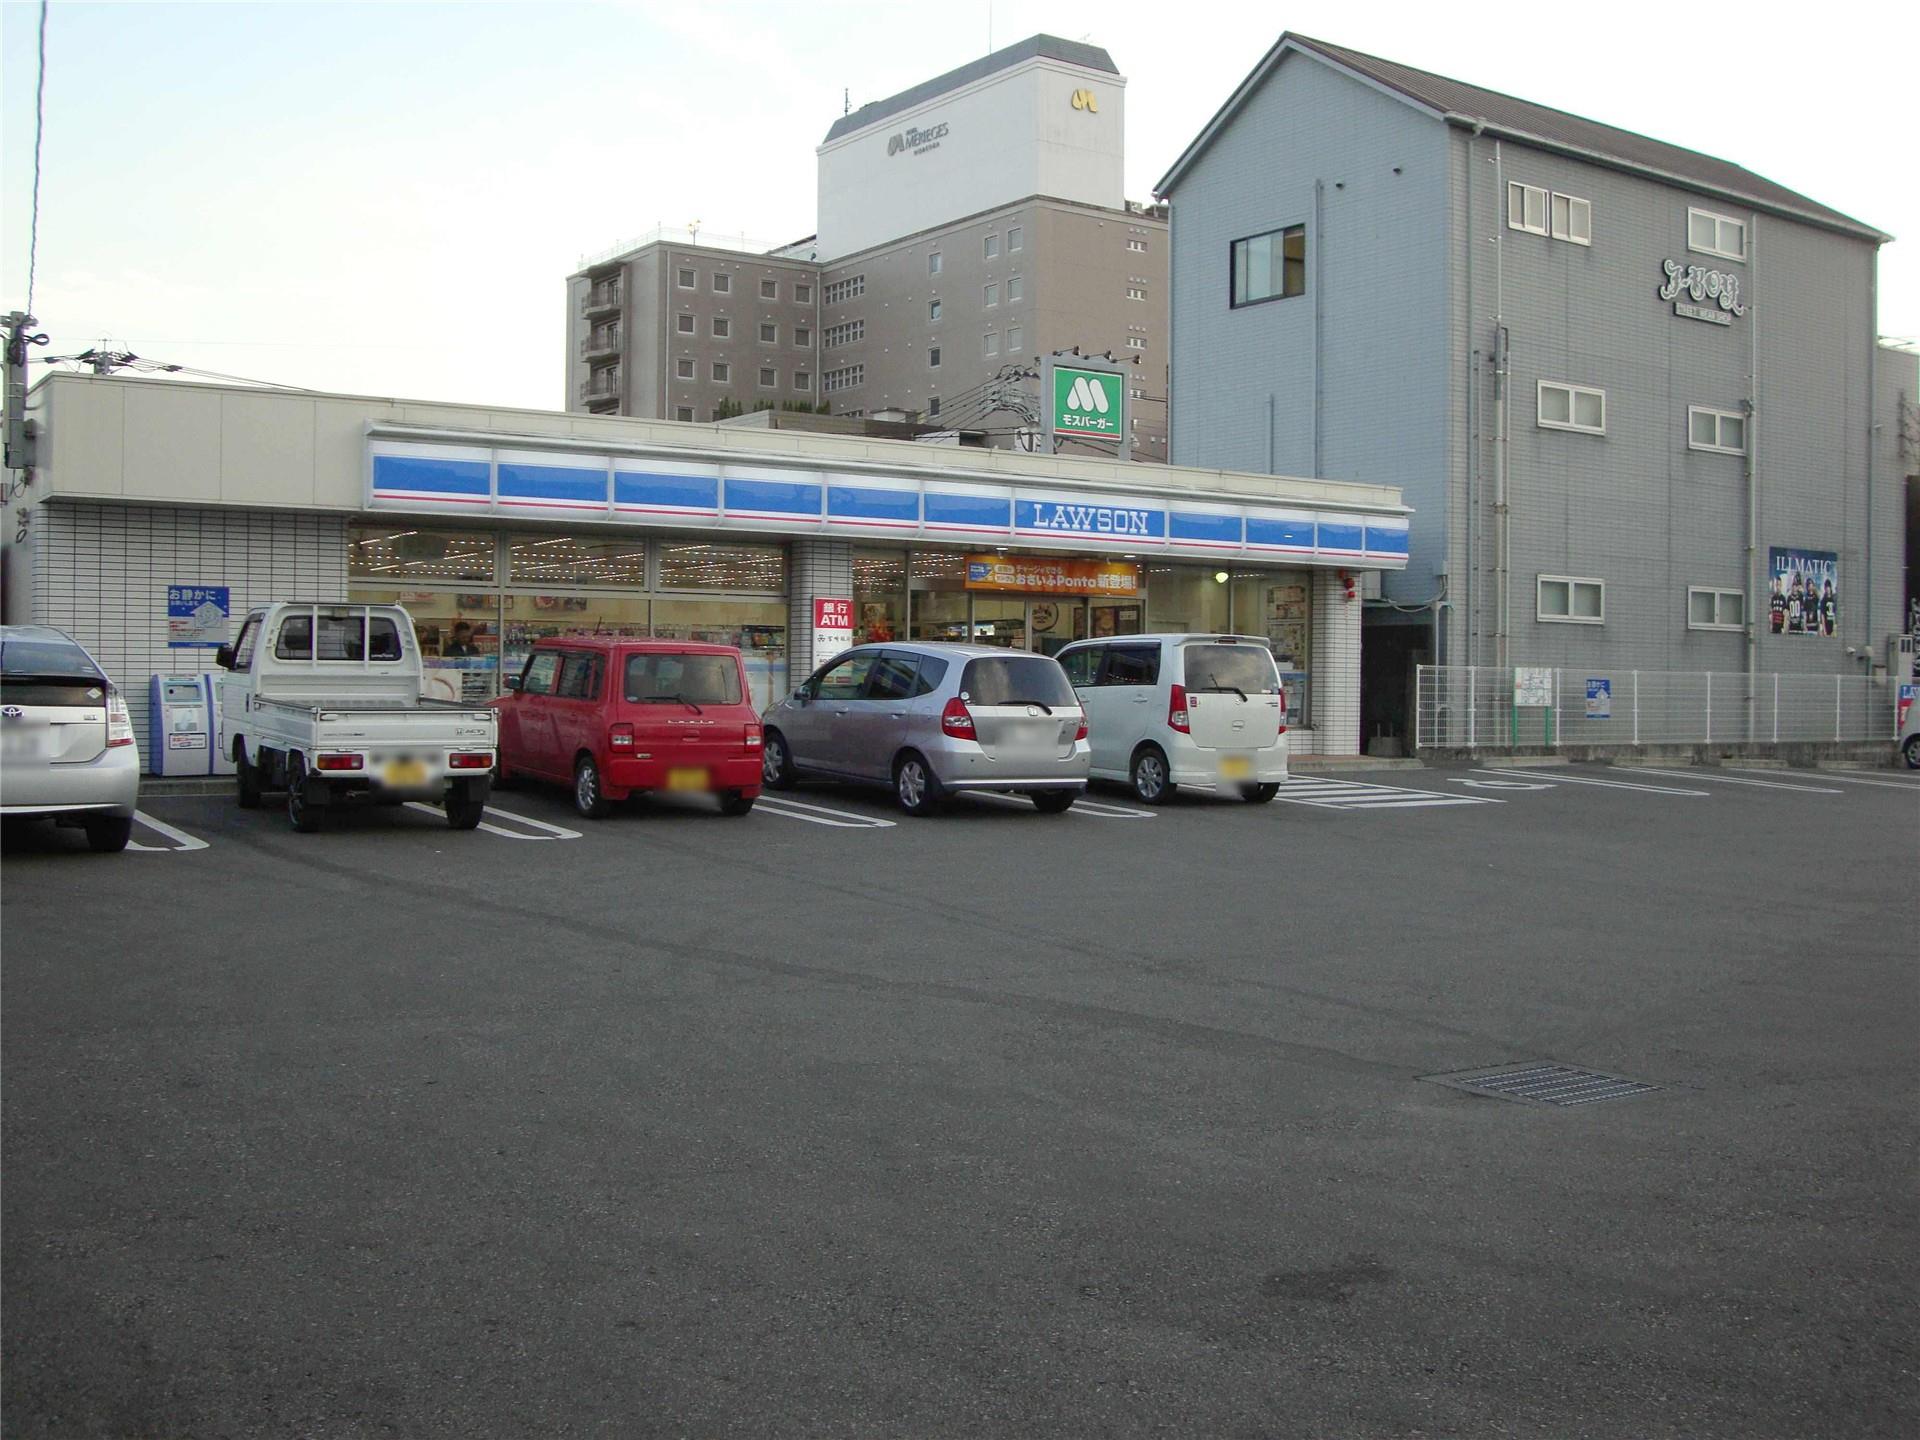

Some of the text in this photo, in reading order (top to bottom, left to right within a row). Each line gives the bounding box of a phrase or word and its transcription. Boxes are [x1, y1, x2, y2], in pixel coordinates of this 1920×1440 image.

[1063, 414, 1114, 429] モスバーガー
[1033, 503, 1149, 534] LAWSON
[1776, 555, 1832, 575] ILLMATIC
[169, 589, 216, 601] お静かに
[823, 602, 848, 614] 銀行
[820, 614, 848, 626] ATM
